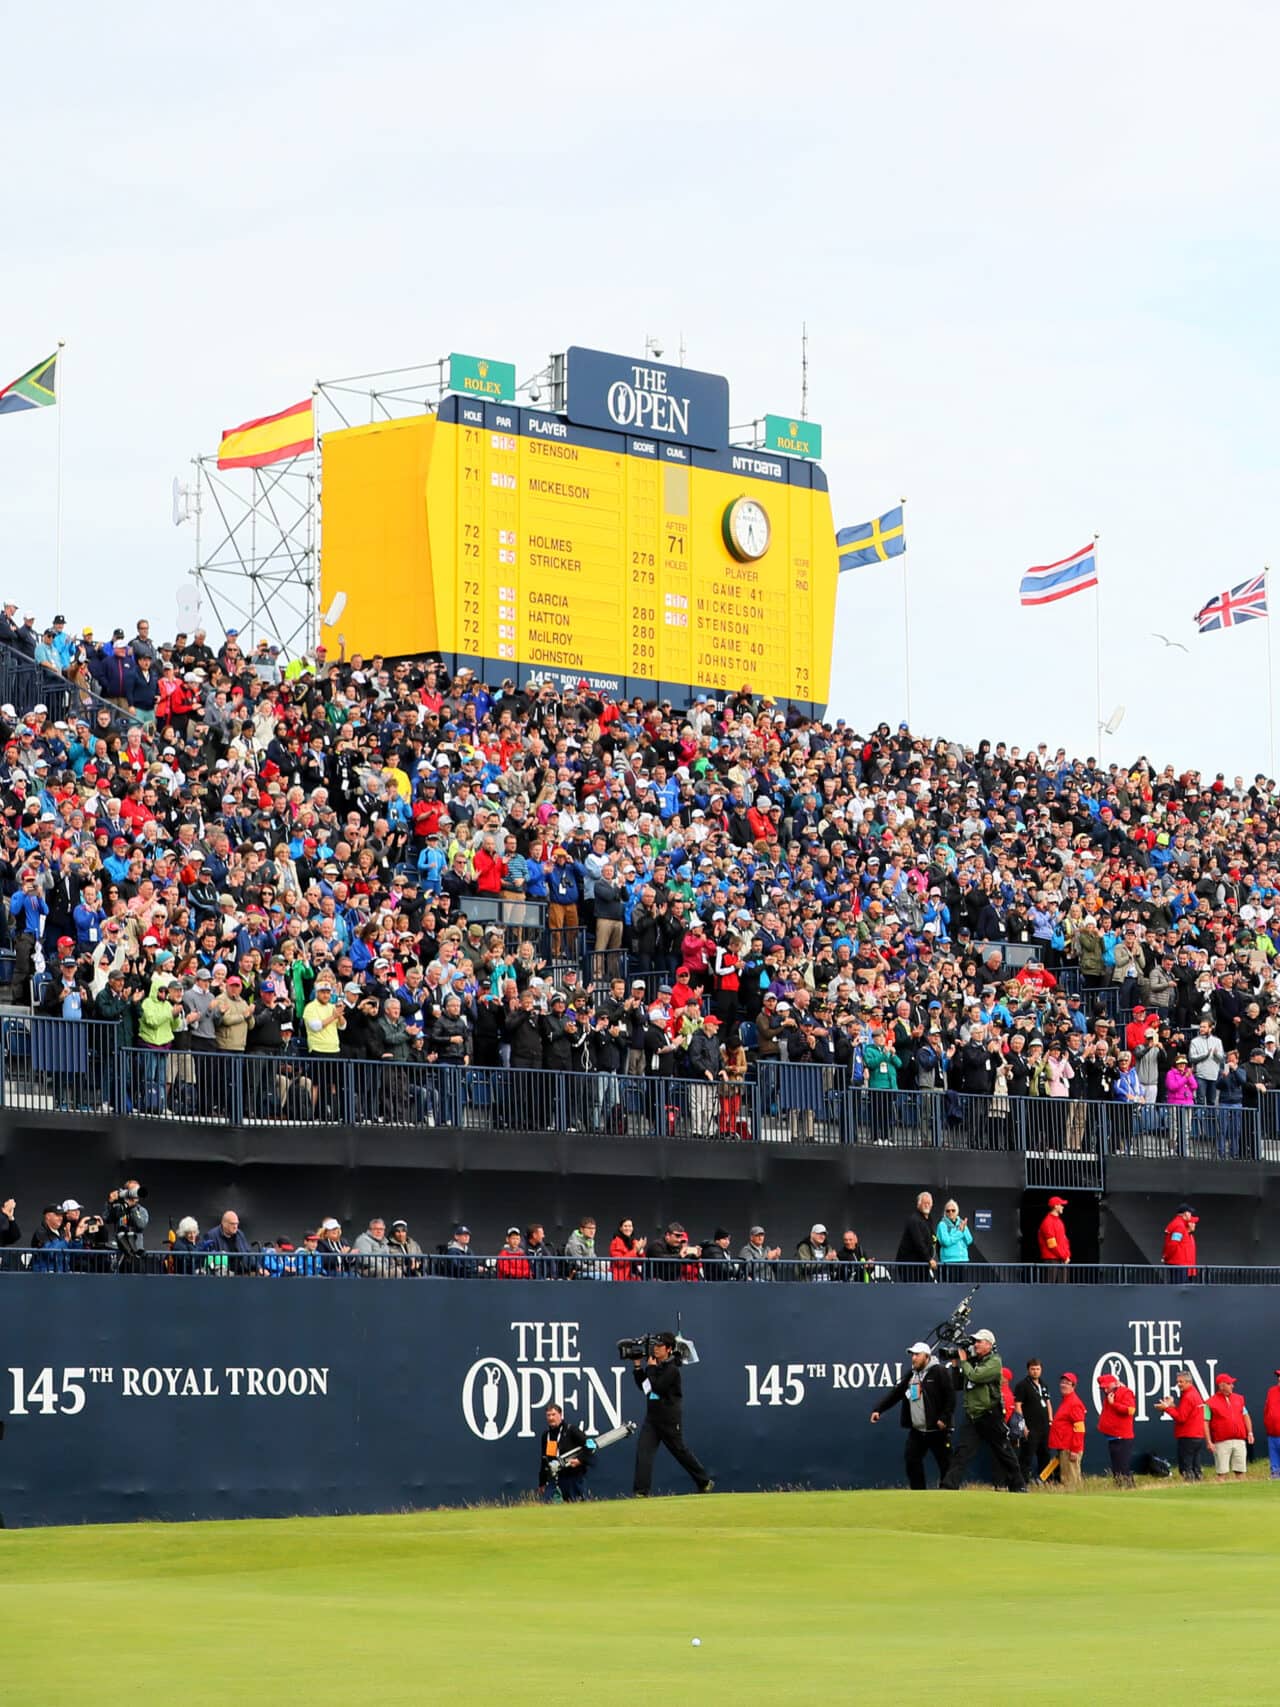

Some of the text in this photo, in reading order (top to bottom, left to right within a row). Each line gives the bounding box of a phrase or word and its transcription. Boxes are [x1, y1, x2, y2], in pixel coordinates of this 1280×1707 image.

[464, 377, 502, 394] ROLEX
[632, 366, 667, 393] THE
[608, 381, 690, 436] OPEN
[464, 410, 567, 438] HOLE PAR PLAYER
[465, 430, 479, 444] 71
[530, 442, 578, 460] STENSON
[633, 441, 656, 454] SCORE
[777, 436, 810, 453] ROLEX
[465, 467, 479, 480] 71
[529, 478, 590, 500] MICKELSON
[666, 521, 688, 534] AFTER
[464, 524, 480, 538] 72
[529, 536, 572, 552] HOLMES
[632, 552, 655, 566] 278
[668, 535, 684, 554] 71
[464, 544, 480, 558] 72
[530, 554, 582, 572] STRICKER
[632, 570, 655, 584] 279
[664, 558, 688, 571] HOLES
[725, 568, 758, 582] PLAYER
[464, 581, 480, 595] 72
[529, 592, 568, 608] GARCIA
[632, 607, 655, 621] 280
[712, 582, 764, 602] GAME 41
[464, 600, 480, 614] 72
[528, 610, 570, 626] HATTON
[632, 626, 655, 640] 280
[697, 598, 764, 620] MICKELSON
[464, 620, 479, 634] 72
[528, 630, 573, 646] McILROY
[632, 644, 655, 658] 280
[697, 617, 750, 636] STENSON
[464, 638, 479, 652] 72
[528, 648, 583, 666] JOHNSTON
[632, 662, 654, 676] 281
[712, 636, 764, 656] GAME 40
[698, 654, 809, 681] JOHNSTON 73
[589, 678, 618, 690] TROON
[698, 671, 809, 698] HAAS 75
[510, 1322, 580, 1362] THE
[1128, 1320, 1183, 1356] THE
[122, 1368, 220, 1396] ROYAL
[226, 1368, 330, 1396] TROON
[462, 1357, 626, 1440] OPEN
